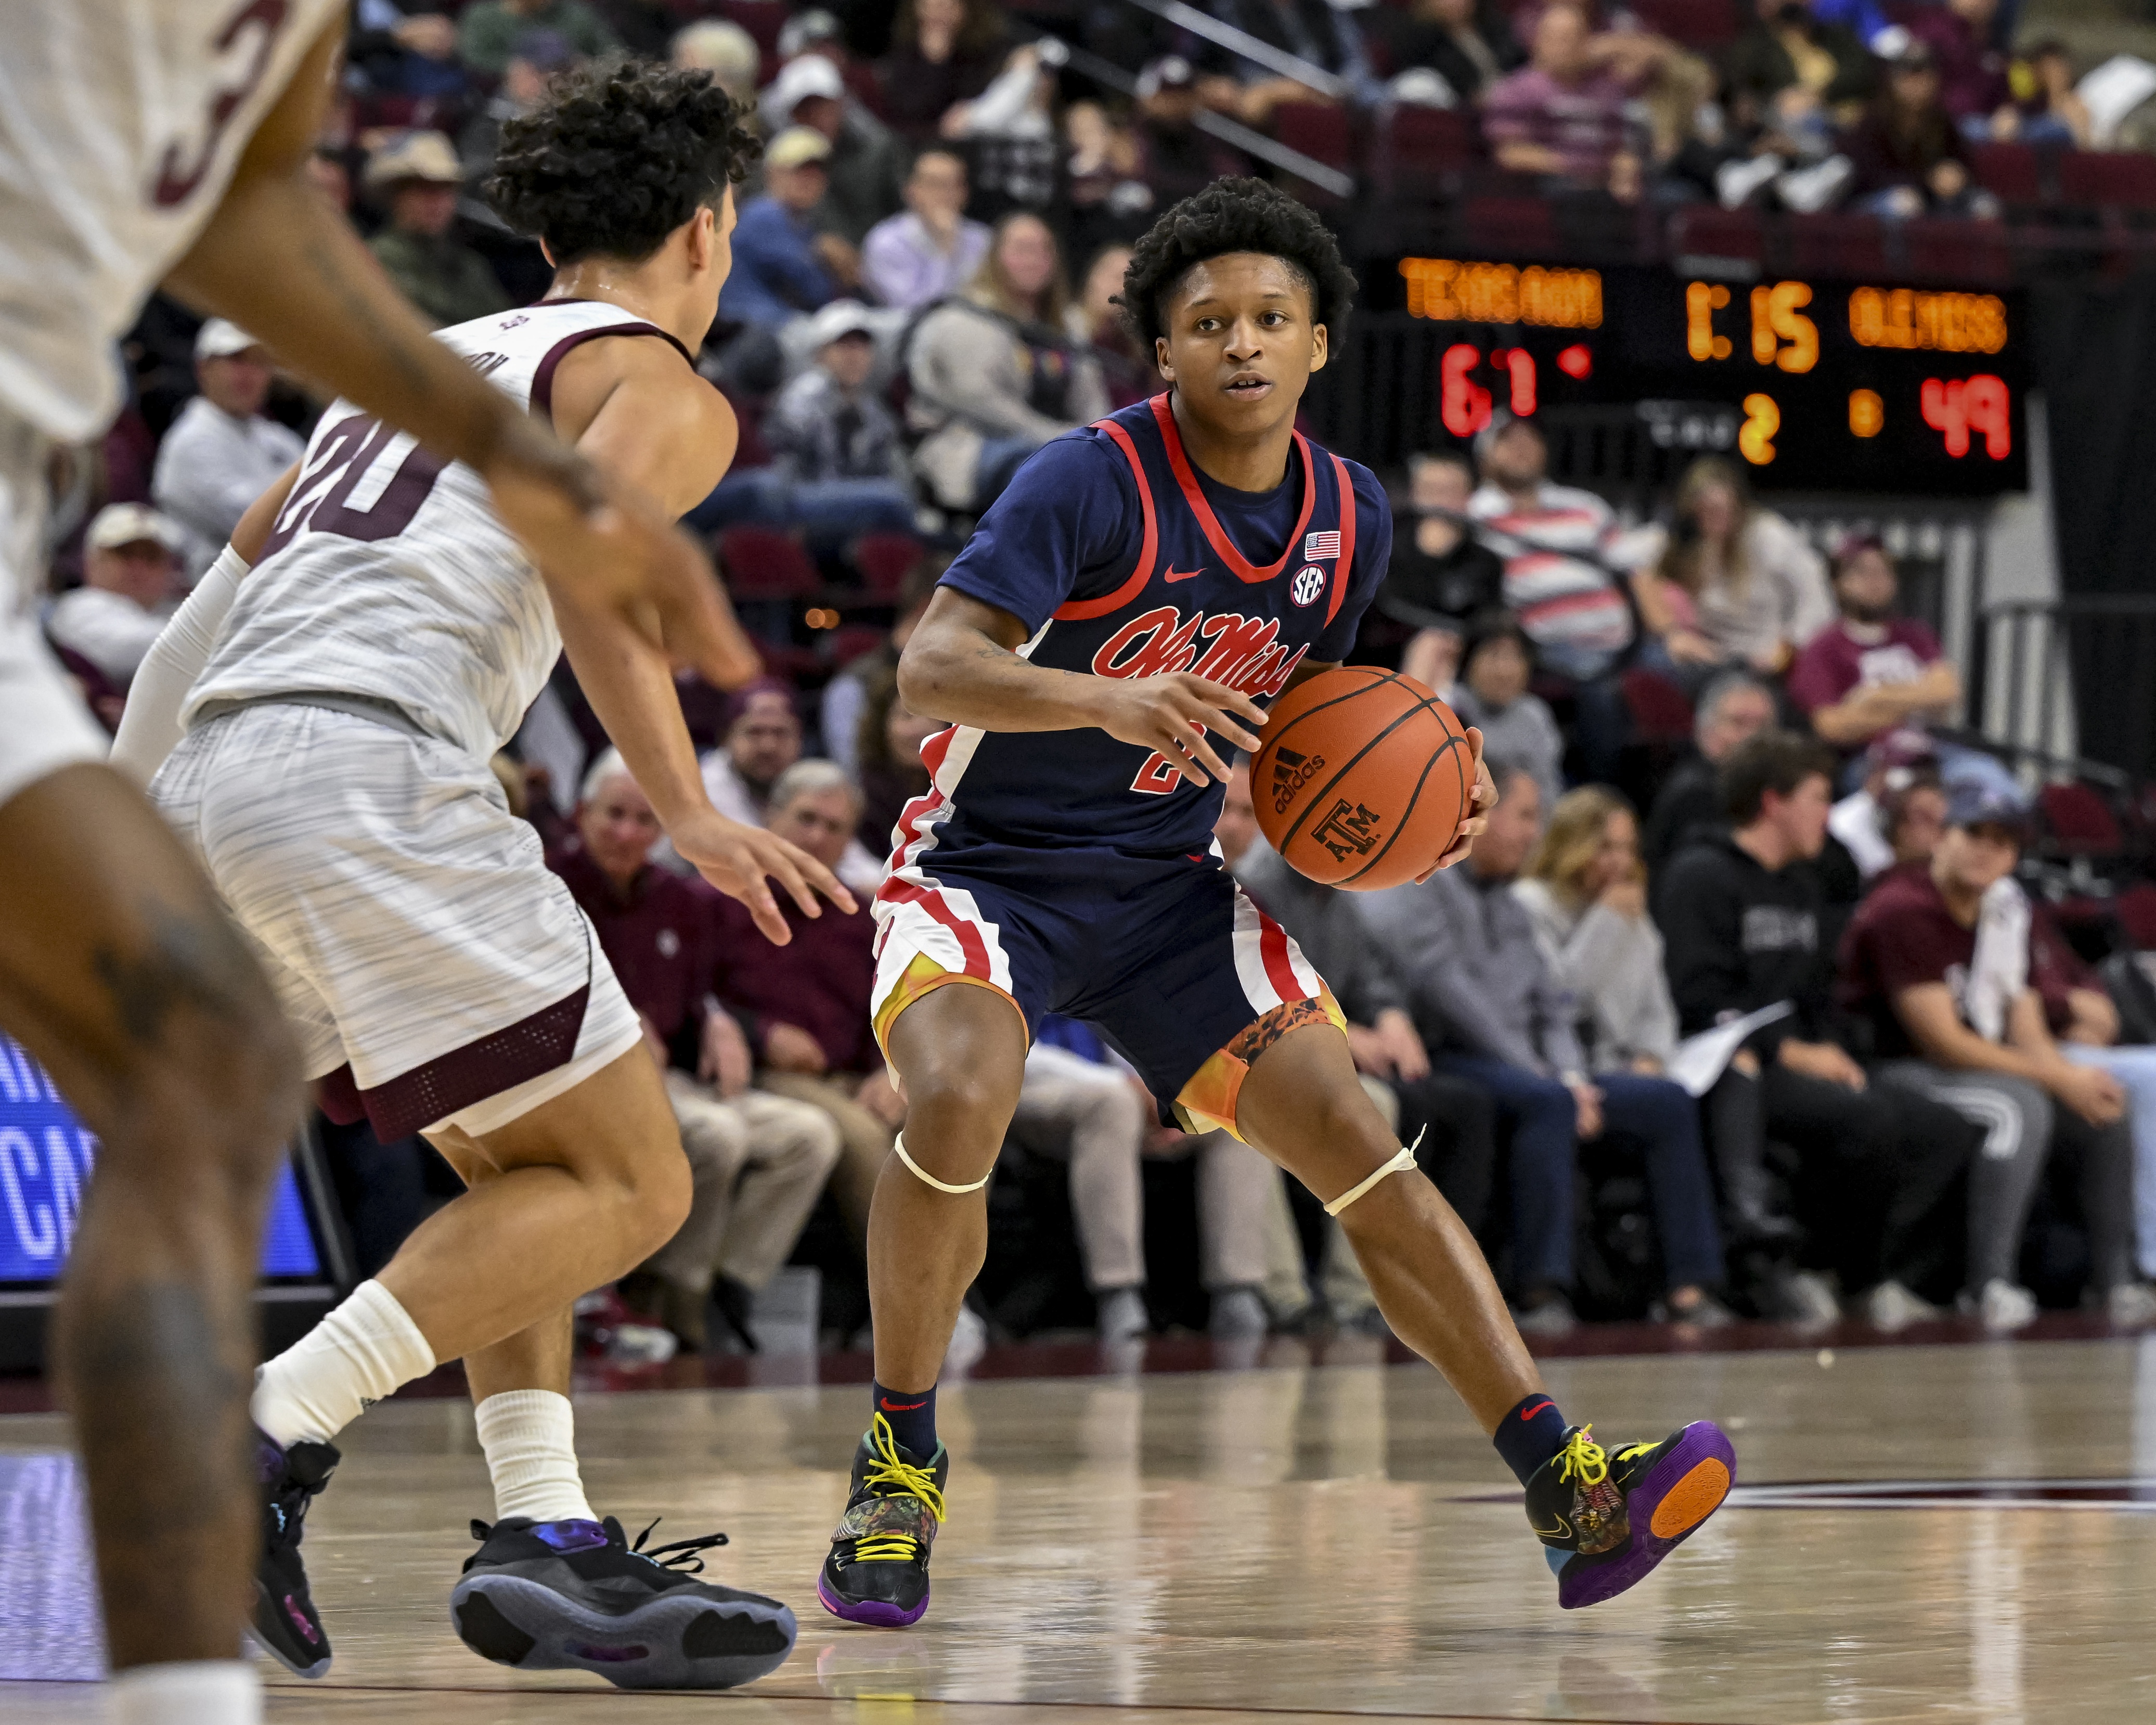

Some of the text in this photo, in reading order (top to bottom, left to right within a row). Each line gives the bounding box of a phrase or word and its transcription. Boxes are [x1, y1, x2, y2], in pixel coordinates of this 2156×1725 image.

[1739, 393, 1780, 465] 2
[1921, 374, 2011, 460] 49
[1294, 567, 1323, 604] SEC
[1190, 613, 1310, 698] Miss
[1275, 755, 1325, 815] adidas
